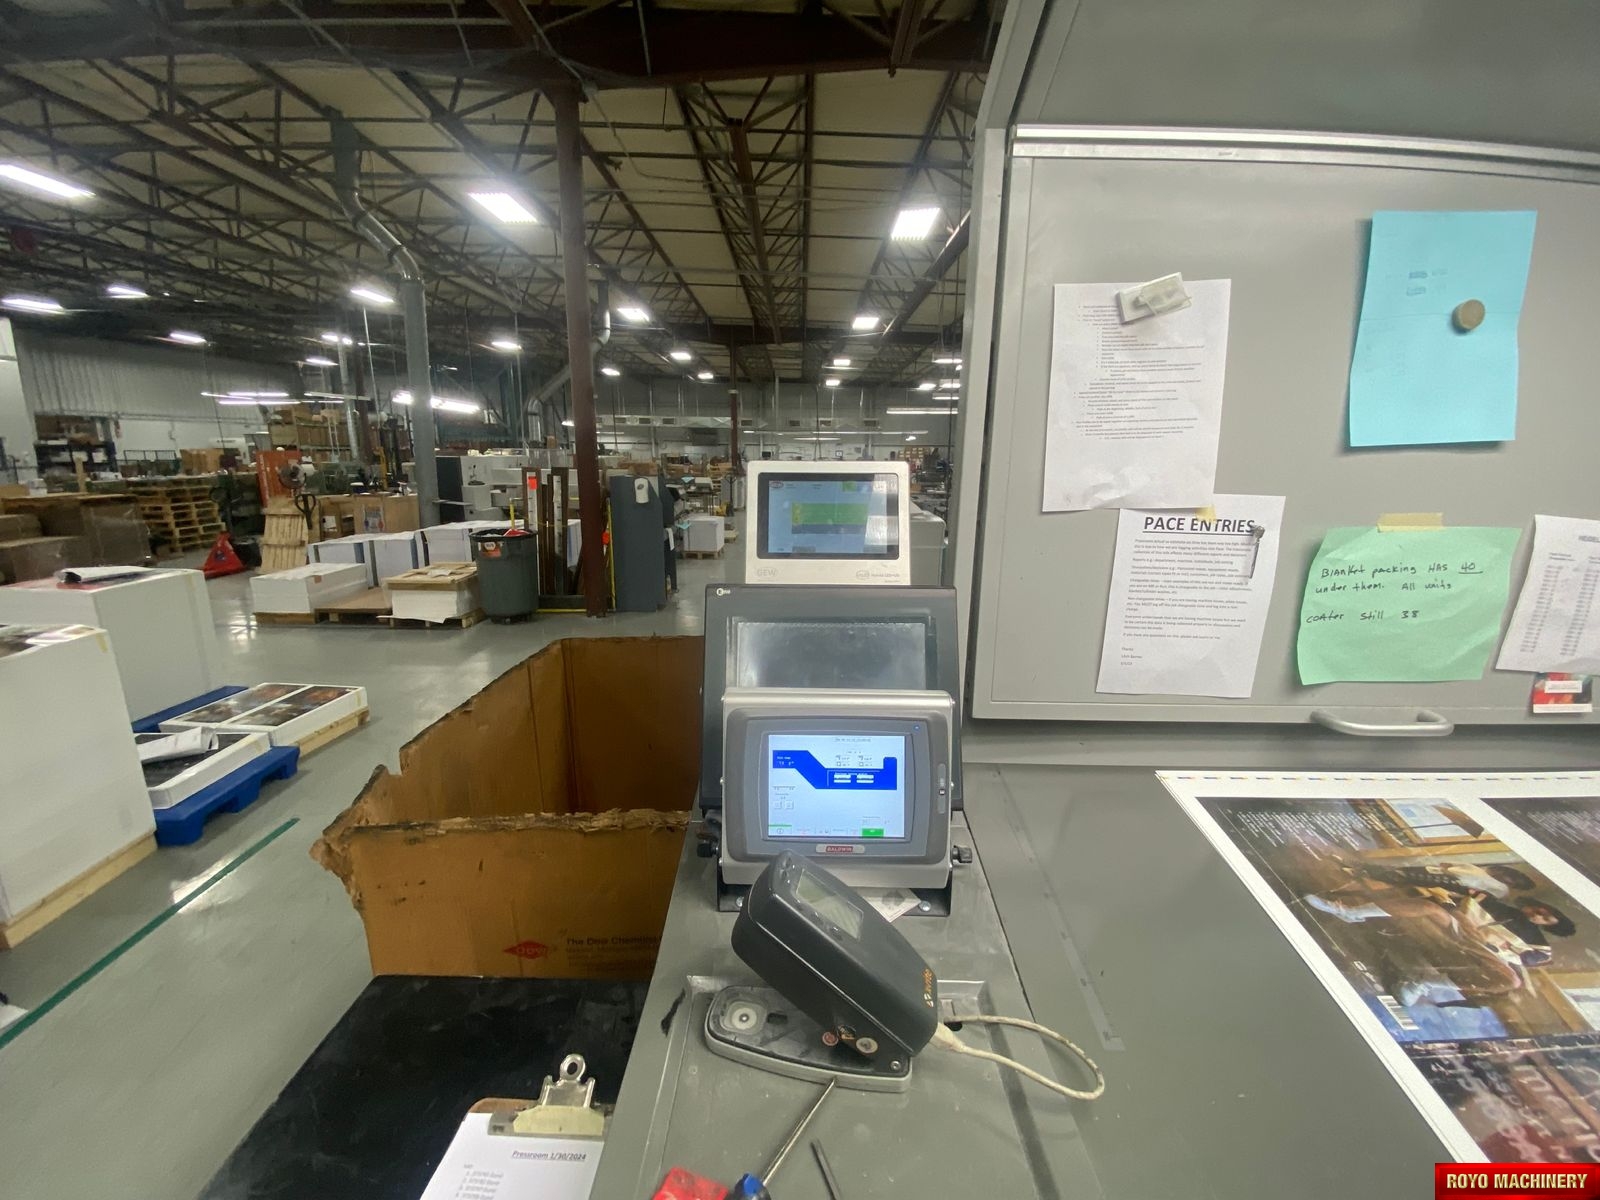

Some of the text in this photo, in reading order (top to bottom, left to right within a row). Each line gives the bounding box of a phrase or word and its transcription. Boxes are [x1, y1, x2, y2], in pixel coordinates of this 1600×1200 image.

[1143, 516, 1255, 534] PACE ENTRIES
[1427, 562, 1448, 573] HAS
[1460, 562, 1478, 573] 40
[1315, 582, 1347, 594] under
[1401, 582, 1416, 591] All
[1401, 610, 1419, 619] 38
[511, 1150, 549, 1160] Pressroom
